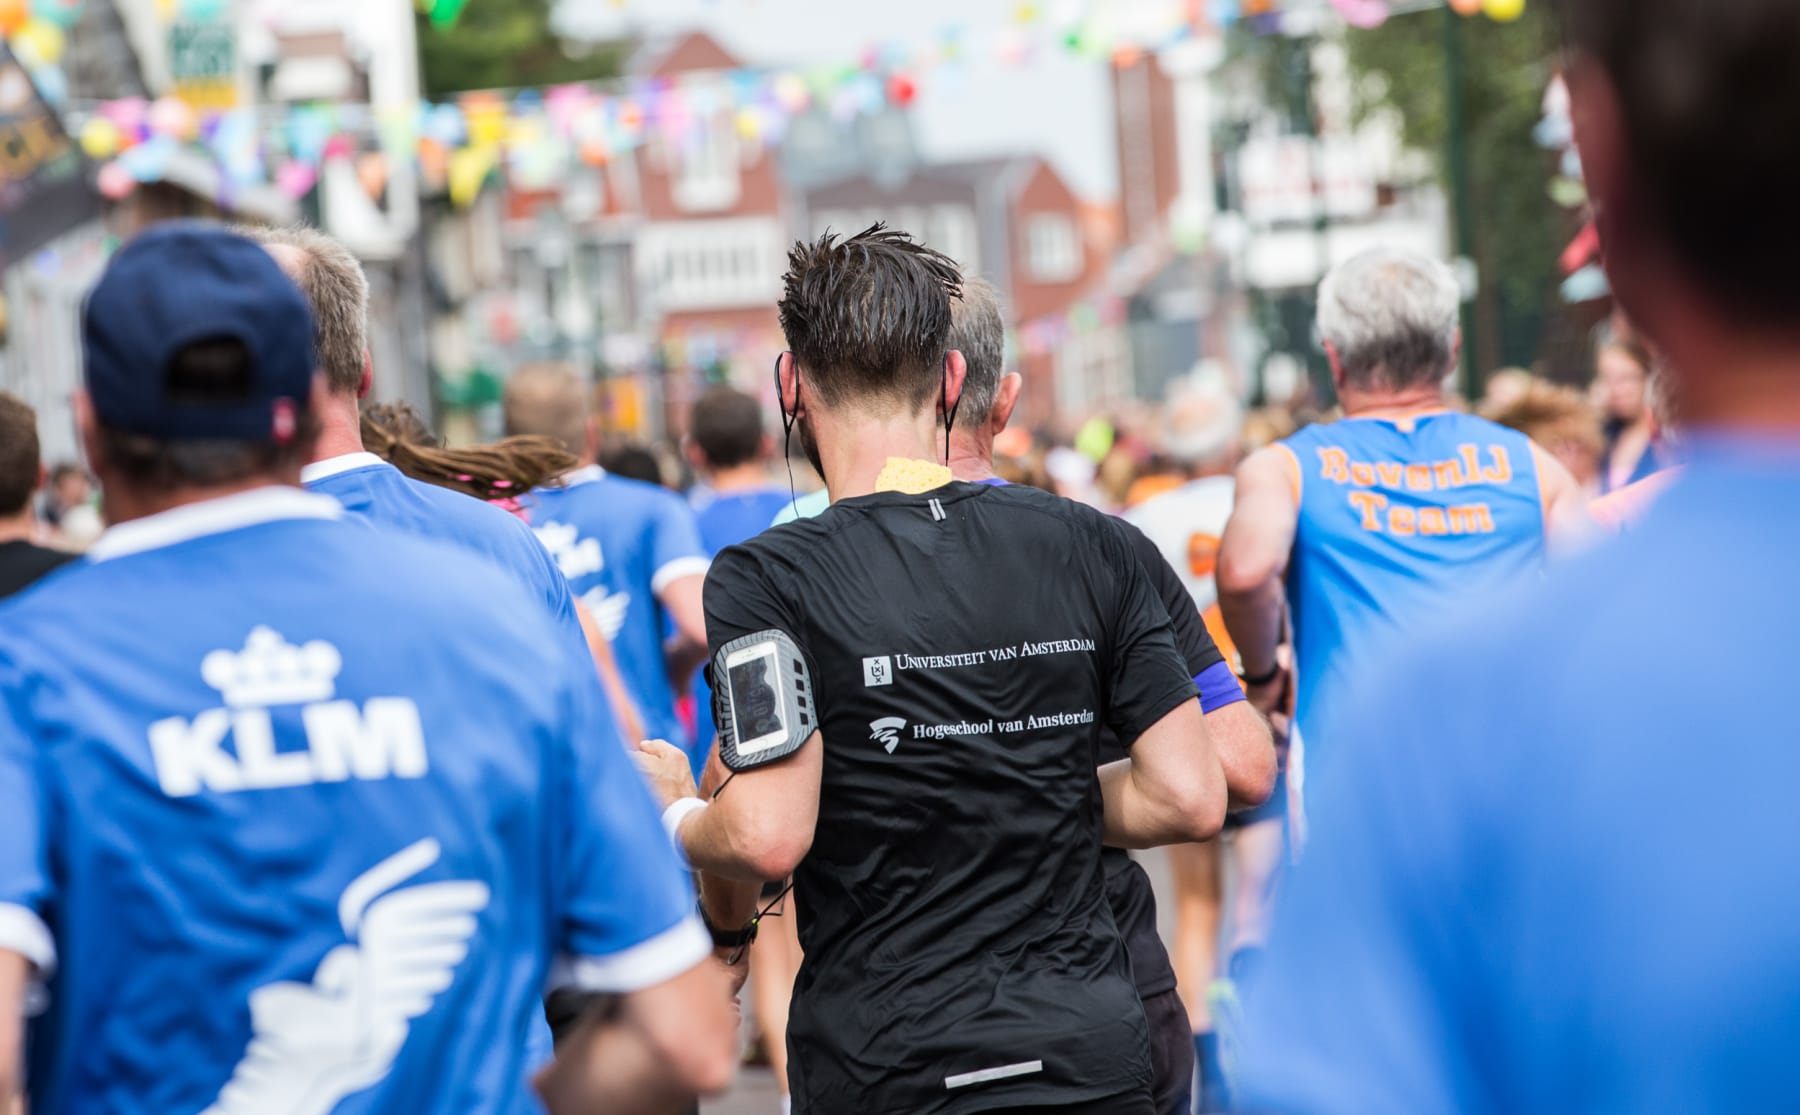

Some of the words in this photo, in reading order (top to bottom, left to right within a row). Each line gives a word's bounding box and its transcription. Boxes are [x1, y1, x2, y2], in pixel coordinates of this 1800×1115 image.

[1317, 443, 1511, 491] BovenIJ
[1348, 490, 1494, 535] Team
[894, 652, 986, 670] UNIVERSITEIT
[990, 646, 1017, 662] VAN
[1021, 638, 1096, 657] AMSTERDAM
[149, 697, 427, 797] KLM
[912, 719, 994, 740] Hogeschool
[997, 721, 1024, 734] van
